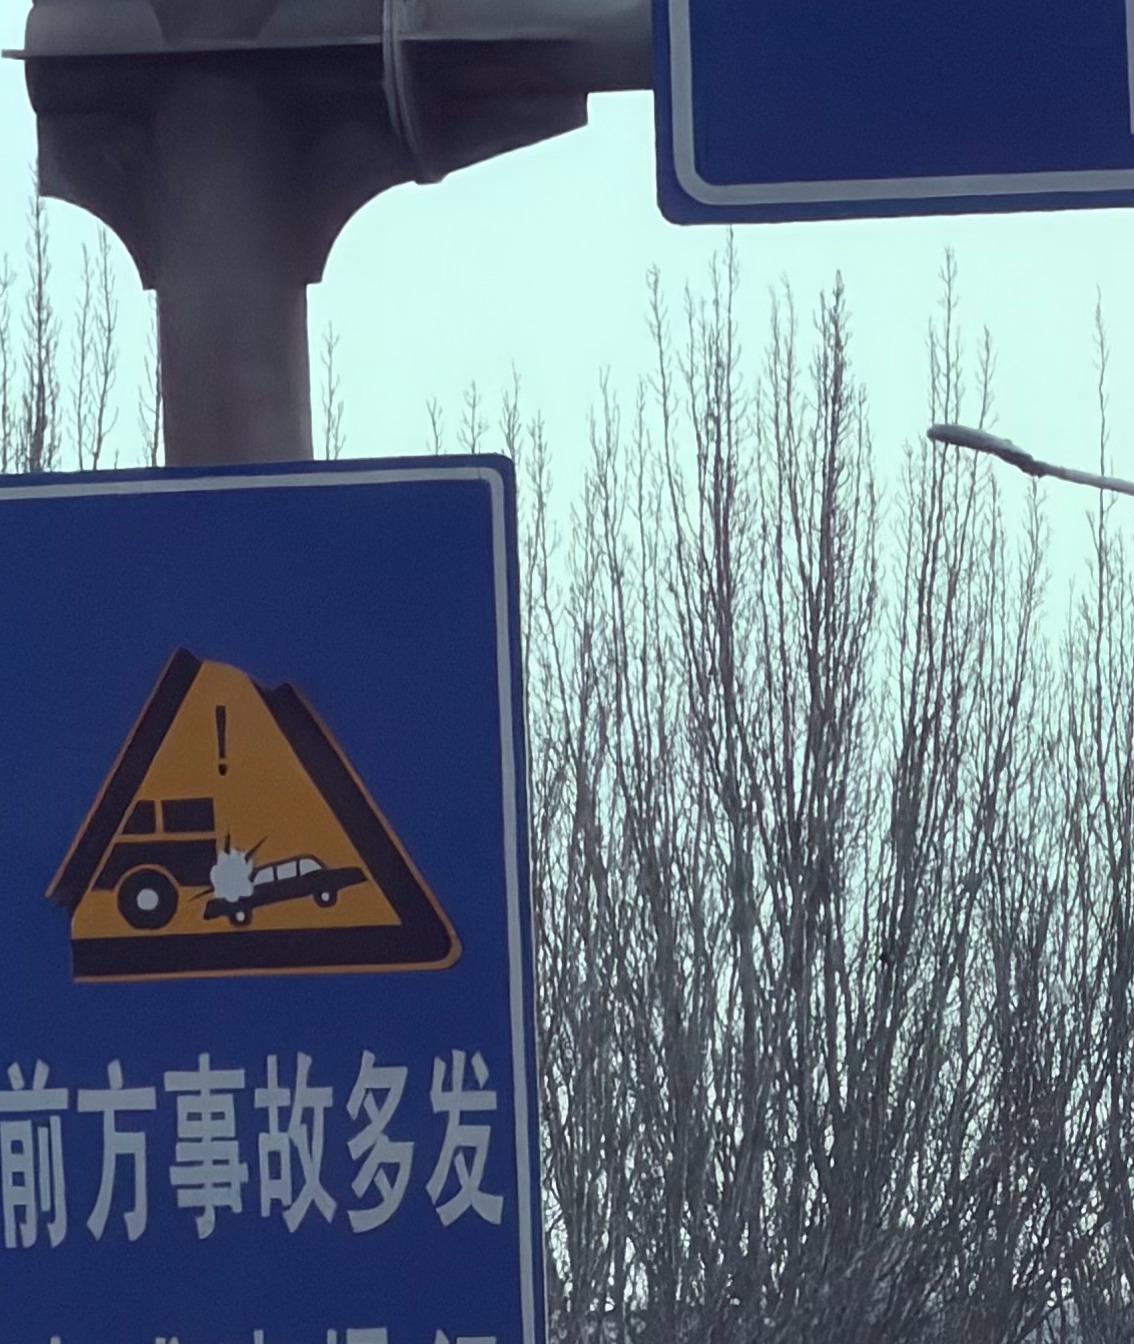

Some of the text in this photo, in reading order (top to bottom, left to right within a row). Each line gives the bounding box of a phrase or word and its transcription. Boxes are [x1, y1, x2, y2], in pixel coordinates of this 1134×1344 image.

[0, 1050, 504, 1248] 前方事故多发
